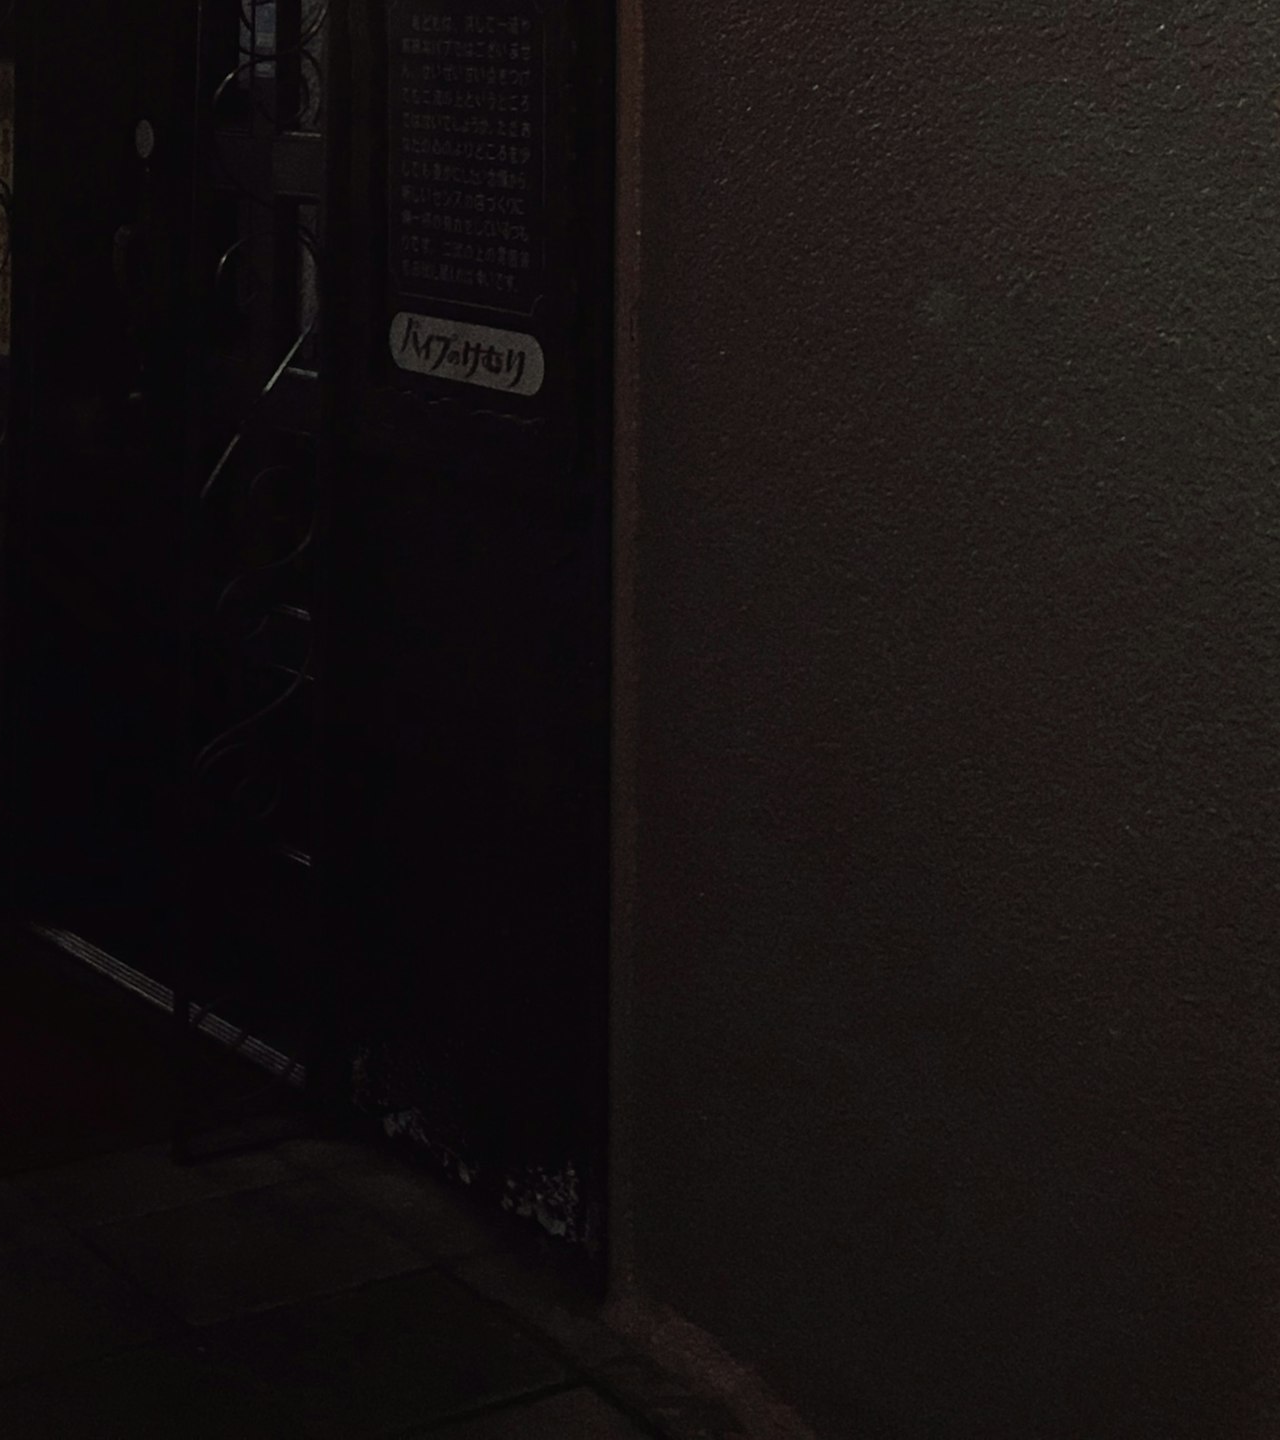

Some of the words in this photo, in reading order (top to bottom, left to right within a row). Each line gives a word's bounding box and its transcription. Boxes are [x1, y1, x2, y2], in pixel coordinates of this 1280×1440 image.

[400, 317, 526, 387] パイプのけむり
